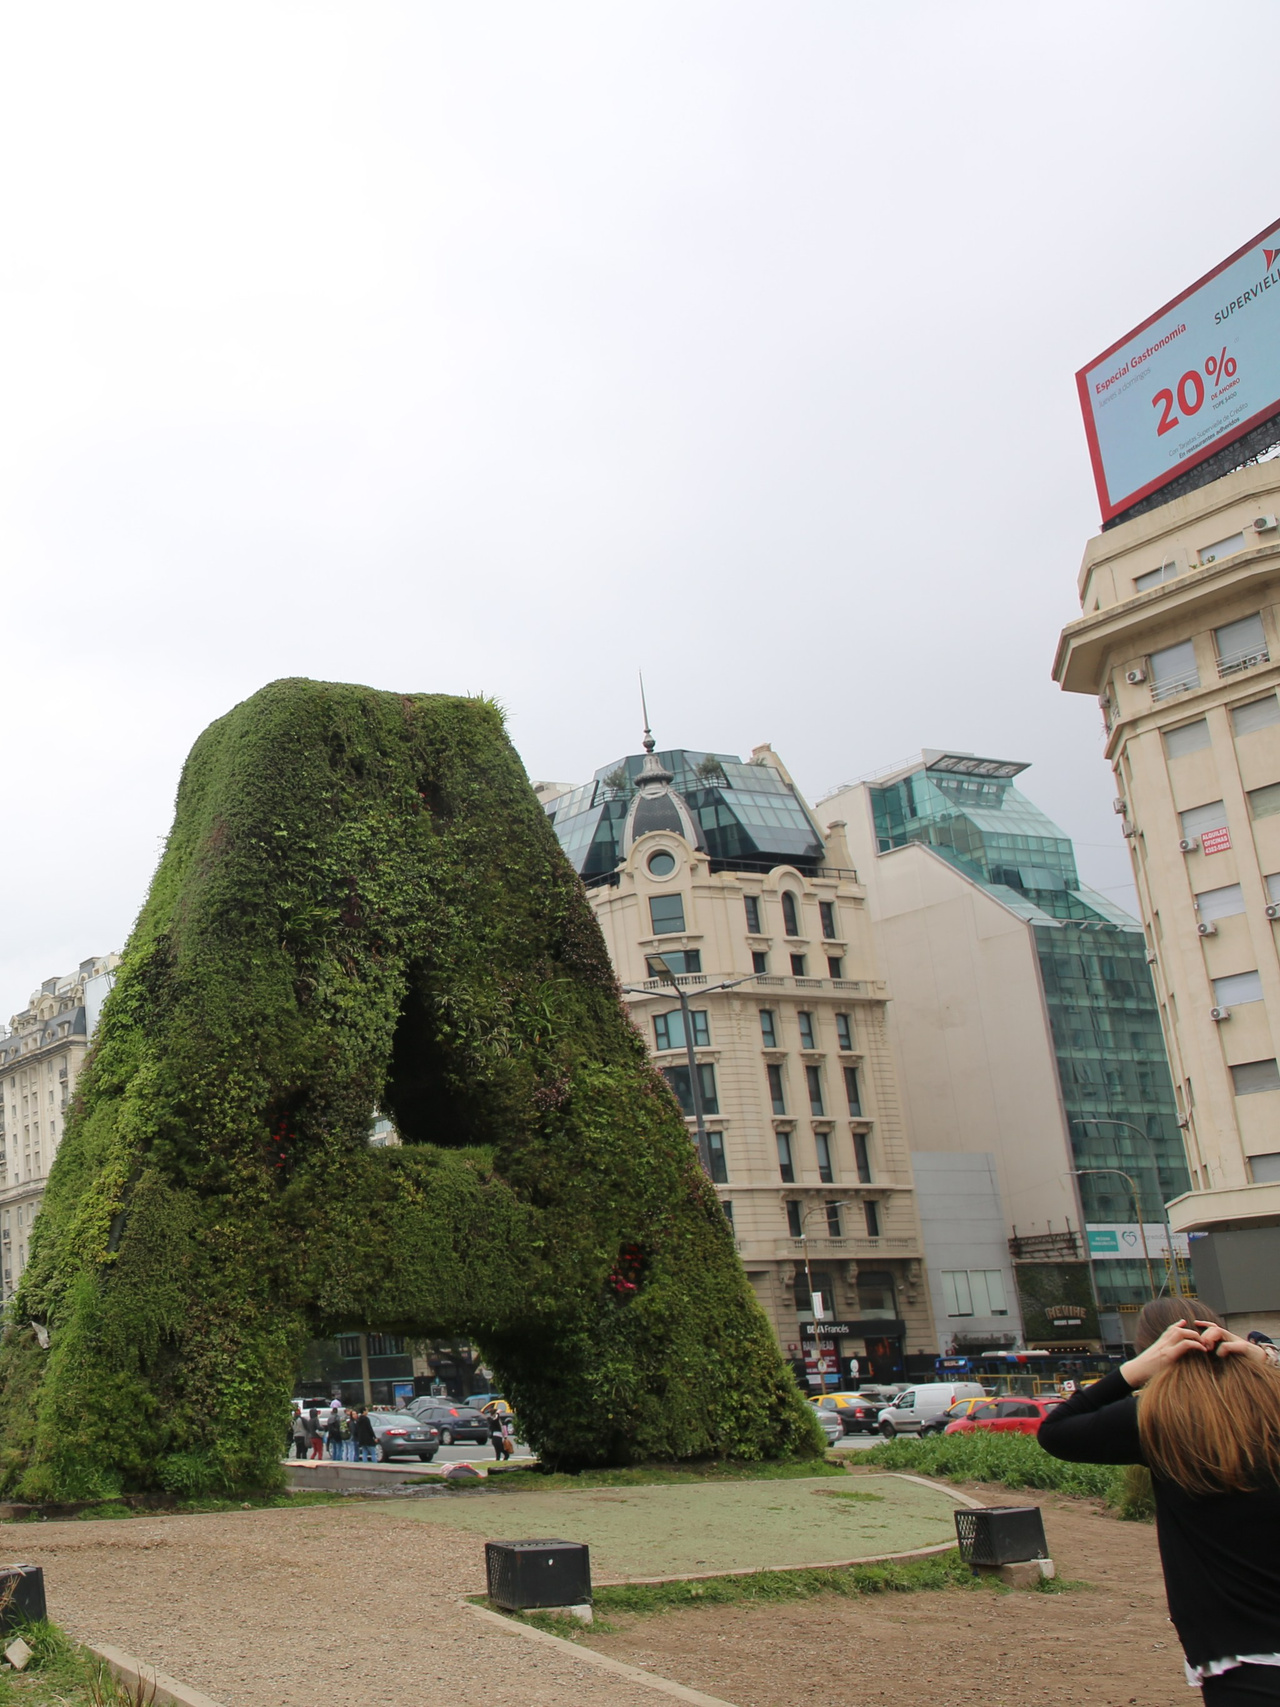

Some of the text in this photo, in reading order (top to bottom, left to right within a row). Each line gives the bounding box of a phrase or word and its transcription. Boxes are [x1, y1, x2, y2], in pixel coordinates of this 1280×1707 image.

[1095, 323, 1187, 394] Especial Gastronomía
[1151, 346, 1237, 437] 20%
[1210, 377, 1241, 401] DE AHORRO
[1178, 432, 1197, 450] Tarjetas
[1186, 432, 1216, 455] restaurantes
[1216, 417, 1240, 435] adheridos
[824, 1324, 850, 1334] Francés
